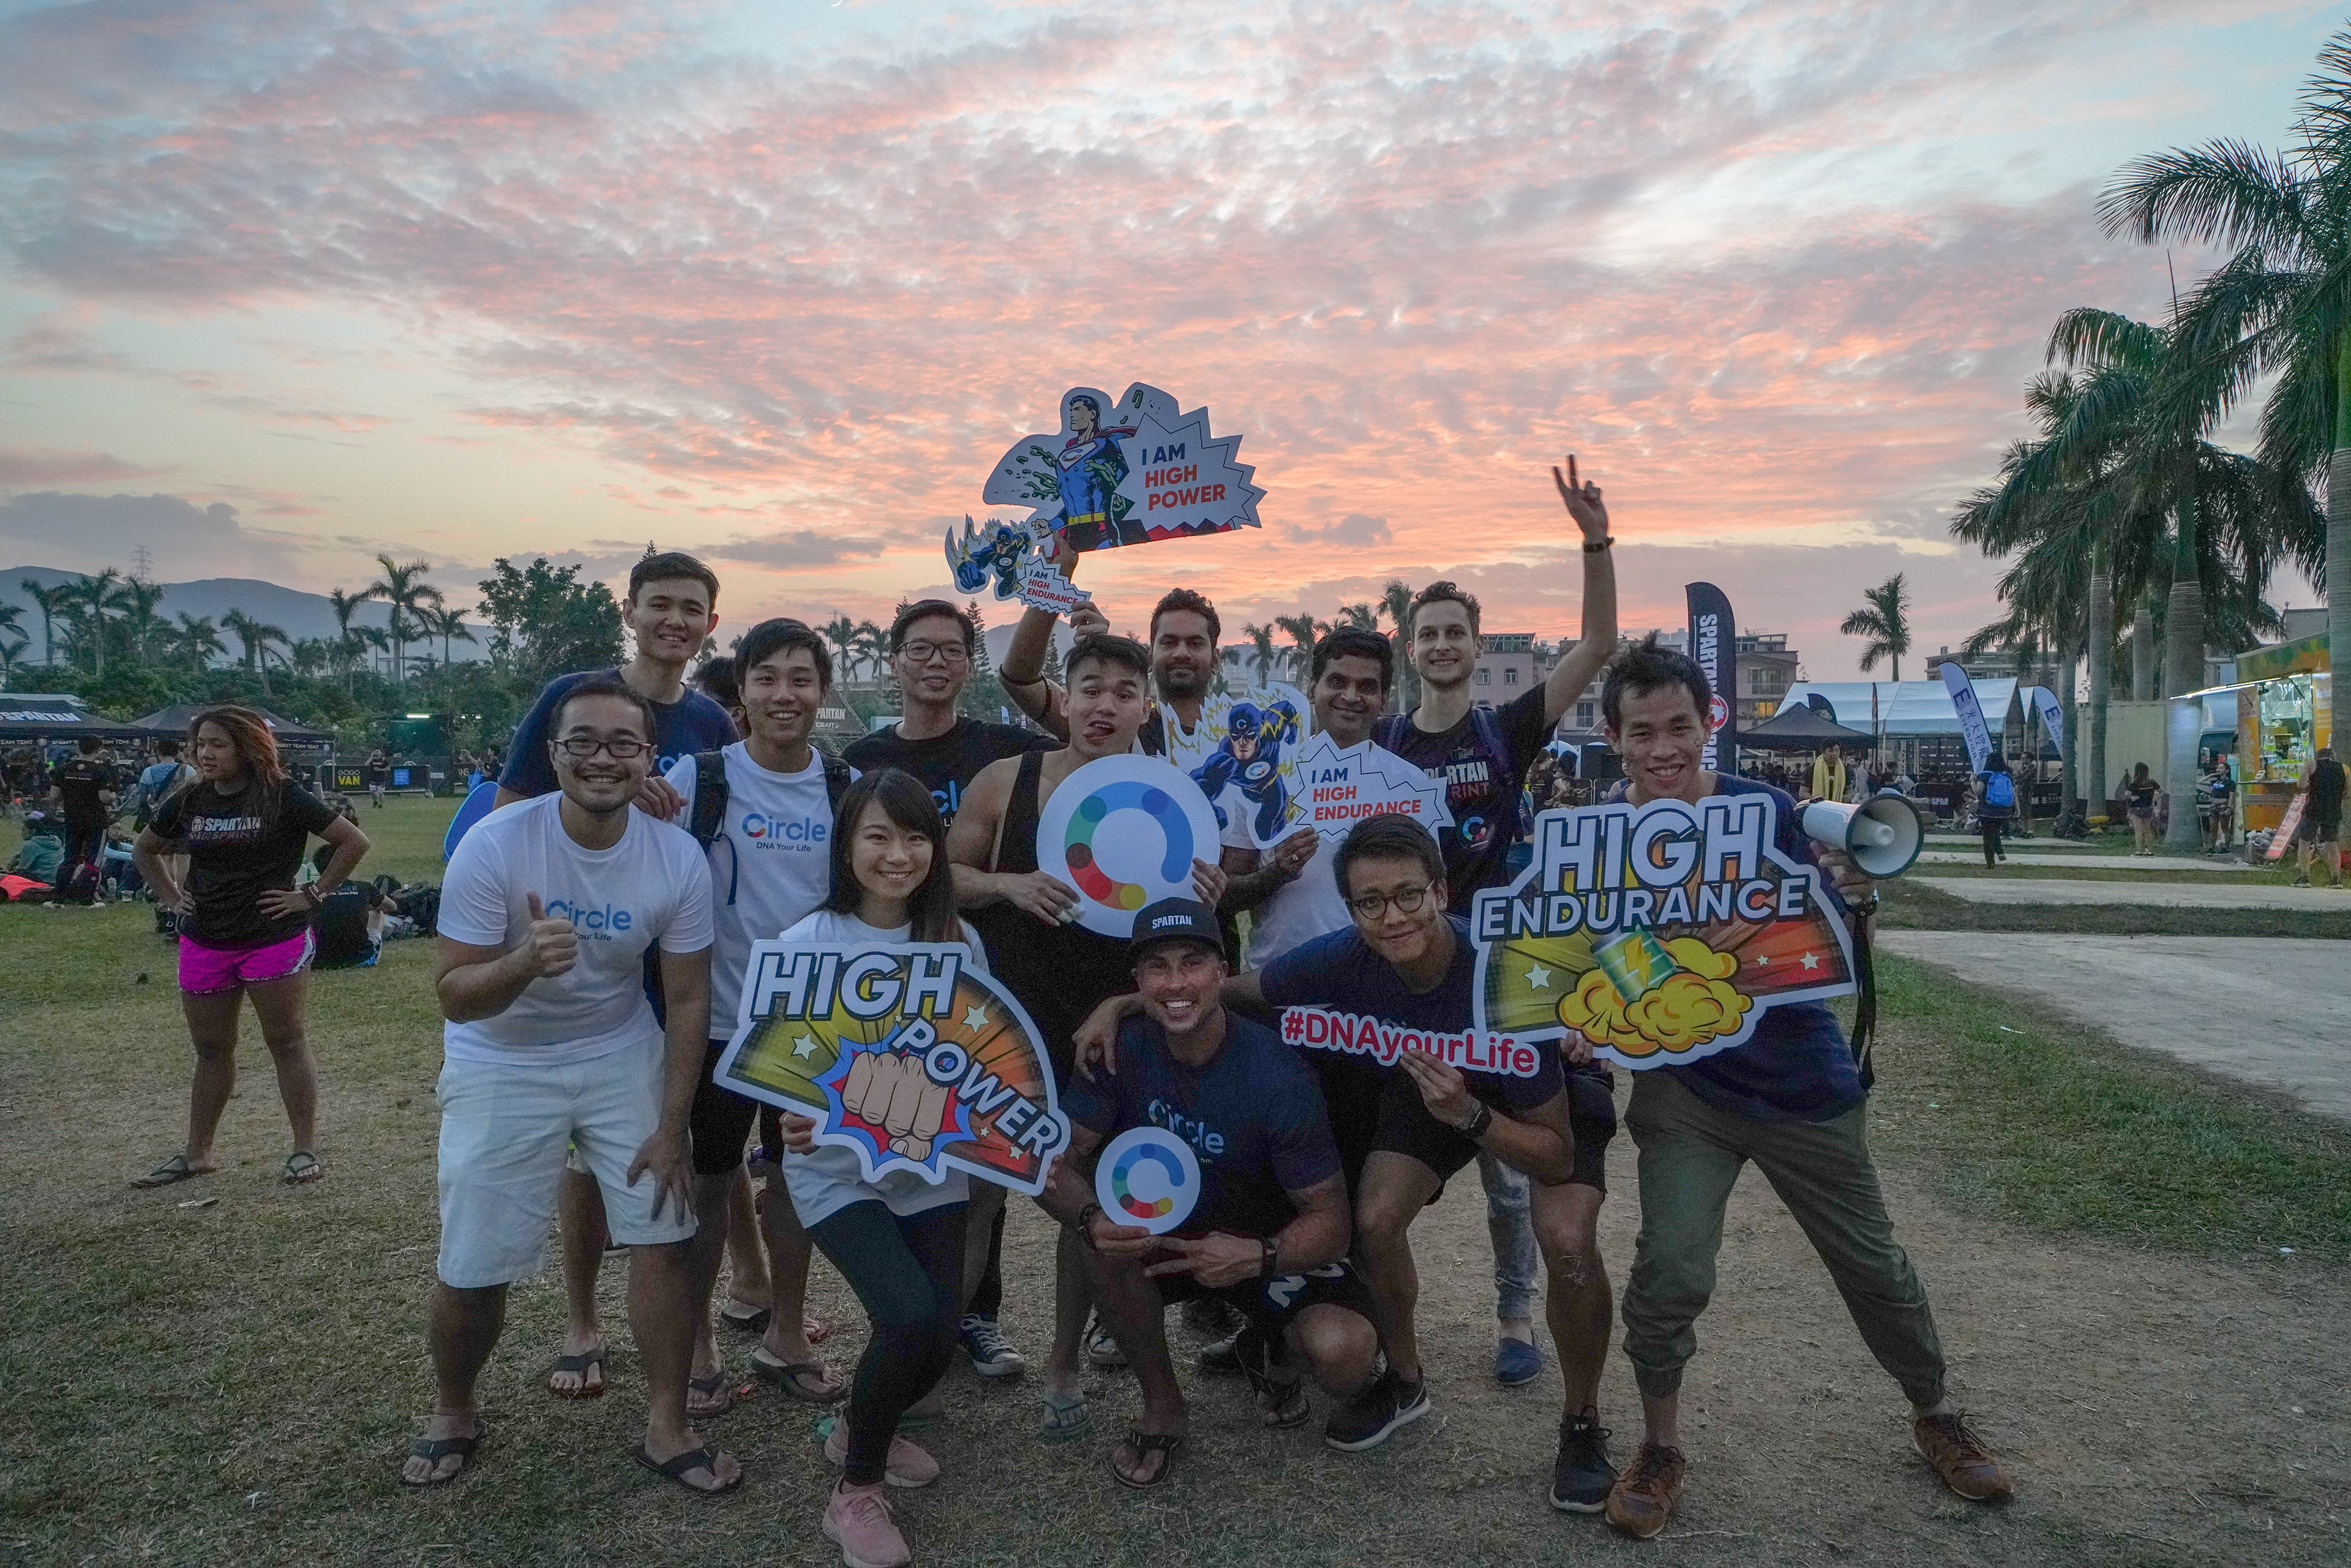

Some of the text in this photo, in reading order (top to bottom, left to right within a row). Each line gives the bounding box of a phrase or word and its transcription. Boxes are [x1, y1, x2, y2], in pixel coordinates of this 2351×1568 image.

[1142, 443, 1185, 465] I AM
[1146, 464, 1198, 488] HIGH
[1148, 484, 1226, 511] POWER
[1028, 579, 1050, 589] HIGH
[1033, 571, 1048, 580] AM
[1026, 588, 1078, 604] ENDURANCE
[1, 711, 81, 722] SPARTAN
[816, 707, 846, 719] PARTAN
[337, 776, 360, 786] VAN
[1311, 767, 1348, 784] I AM
[1313, 786, 1357, 803] HIGH
[1930, 797, 1949, 806] SPAR
[1314, 799, 1422, 821] ENDURANCE
[742, 813, 826, 842] Circle
[1541, 803, 1766, 893] HIGH
[1479, 874, 1809, 942] ENDURANCE
[1152, 914, 1192, 929] SPARTAN
[594, 932, 612, 941] Life
[751, 951, 962, 1022] HIGH
[1284, 1010, 1535, 1073] #DNAyourLife
[889, 1016, 1062, 1158] POWER
